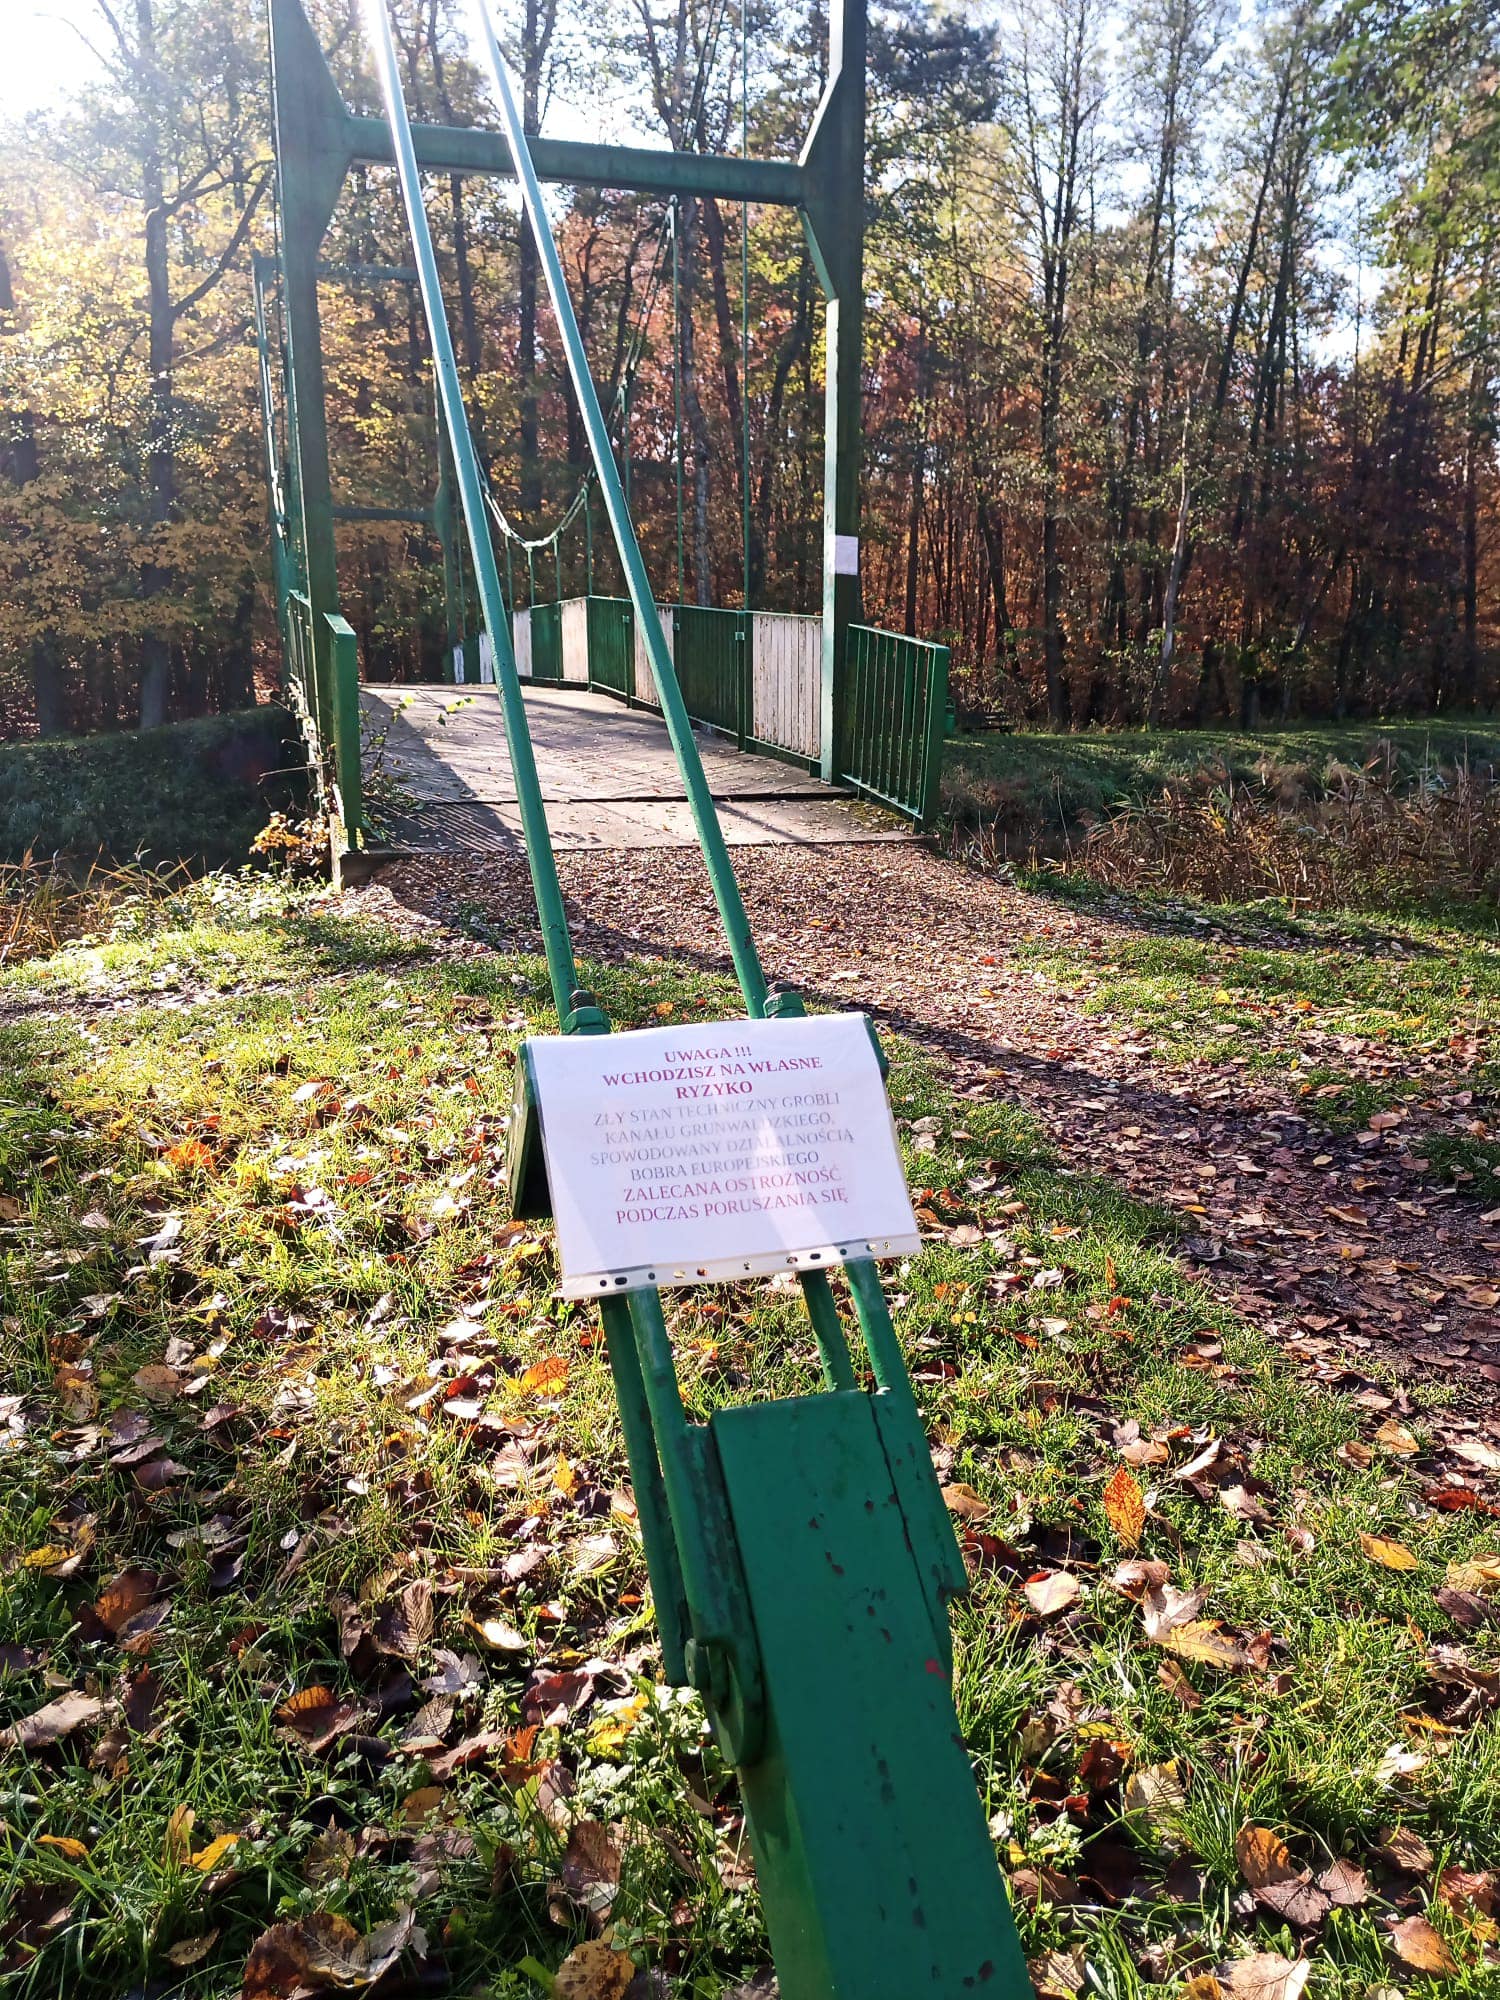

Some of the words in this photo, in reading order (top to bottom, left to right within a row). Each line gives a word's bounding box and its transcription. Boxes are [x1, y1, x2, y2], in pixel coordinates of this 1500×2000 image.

[664, 1047, 732, 1063] UWAGA
[735, 1045, 752, 1057] !!!
[602, 1065, 716, 1086] WCHODZISZ
[721, 1063, 746, 1076] NA
[748, 1057, 823, 1072] WŁASNE
[676, 1080, 753, 1099] RYZYKO
[593, 1111, 625, 1126] ZŁY
[629, 1107, 673, 1123] STAN
[677, 1098, 777, 1119] TECHNICZNY
[782, 1092, 840, 1109] GROBLI
[590, 1141, 721, 1166] SPOWODOWANY
[631, 1164, 687, 1181] BOBRA
[691, 1150, 819, 1176] EUROPEJSKIEGO
[624, 1179, 722, 1202] ZALECANA
[725, 1164, 842, 1191] OSTROŻNOŚĆ
[616, 1203, 699, 1225] PODCZAS
[704, 1191, 818, 1217] PORUSZANIA
[821, 1187, 849, 1204] SIĘ
